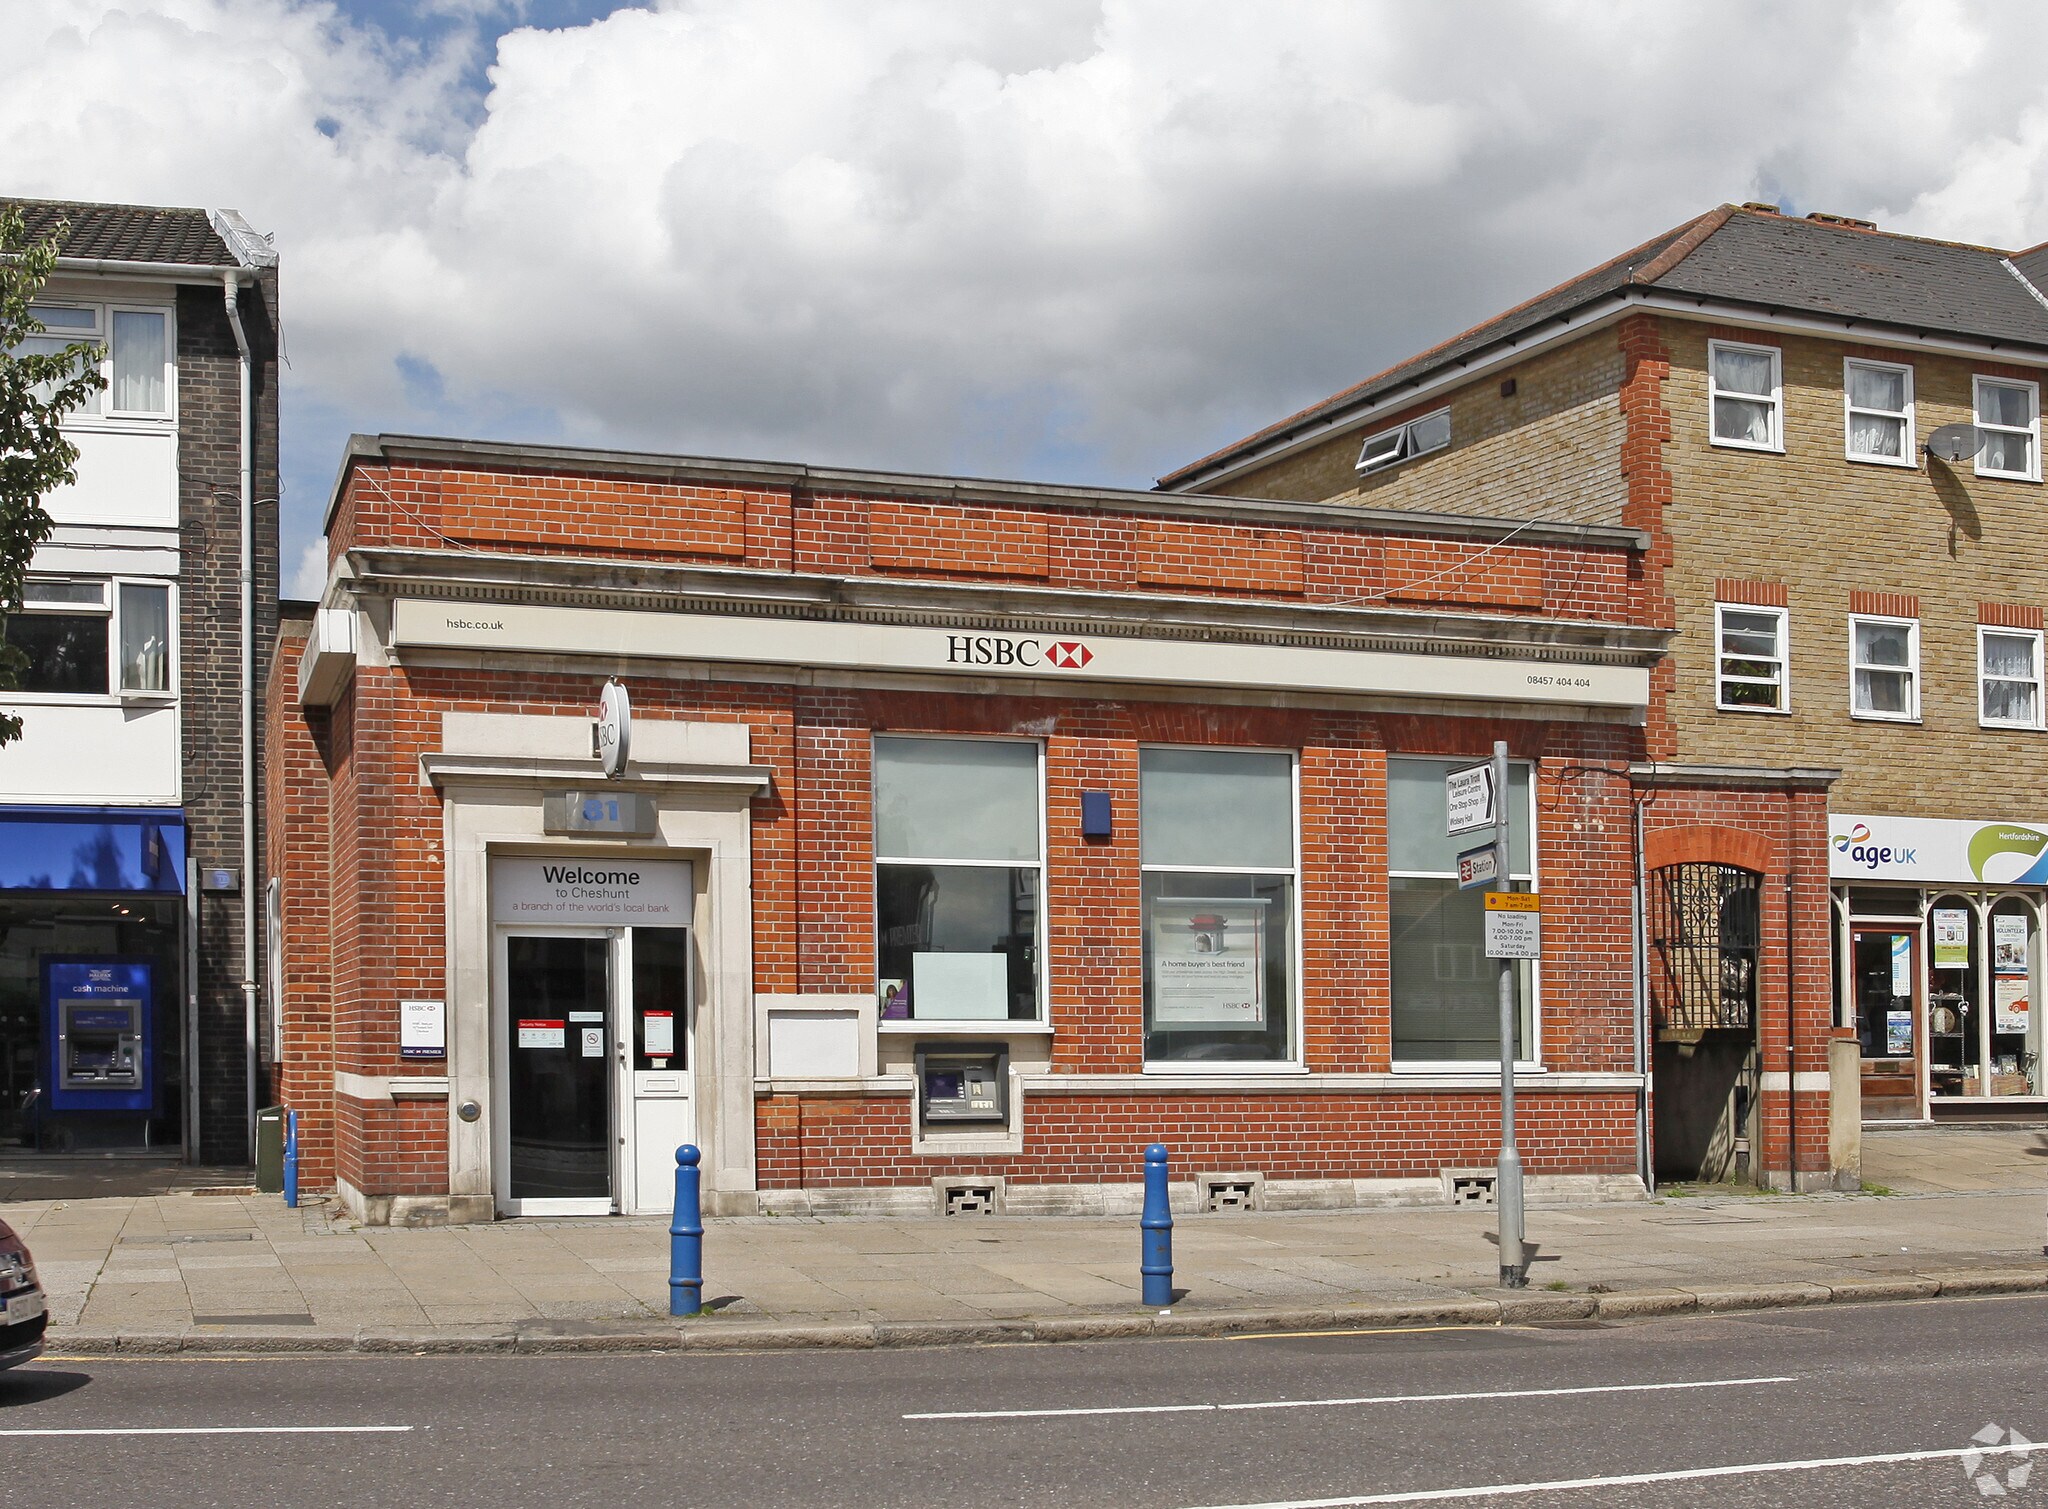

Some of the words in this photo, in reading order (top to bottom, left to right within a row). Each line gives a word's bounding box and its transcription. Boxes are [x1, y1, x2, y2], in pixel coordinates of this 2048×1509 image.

[446, 618, 504, 630] hsbc.co.uk
[946, 635, 1040, 667] HSBC
[1527, 675, 1554, 685] 08457
[1555, 677, 1572, 687] 404
[1574, 678, 1590, 688] 404
[1449, 781, 1457, 789] The
[1457, 777, 1469, 788] Laura
[1452, 788, 1467, 798] Leisure
[1467, 785, 1481, 794] Centre
[583, 799, 619, 821] 81
[1450, 803, 1458, 811] One
[1458, 800, 1468, 810] Stop
[1468, 798, 1479, 807] Shop
[1450, 816, 1465, 826] Wolsey
[1465, 813, 1473, 822] Hall
[1998, 832, 2040, 842] Hertfordshire
[1851, 845, 1892, 870] age
[1893, 847, 1917, 864] UK
[1473, 859, 1492, 874] Station
[543, 866, 641, 885] Welcome
[555, 888, 568, 898] to
[571, 887, 630, 899] Cheshunt
[512, 903, 519, 911] a
[521, 902, 553, 911] branch
[555, 902, 566, 911] of
[568, 902, 584, 912] the
[586, 903, 621, 912] world's
[623, 903, 645, 913] local
[647, 904, 670, 913] bank
[1168, 960, 1187, 968] home
[1188, 961, 1211, 969] buyer's
[73, 985, 91, 993] cash
[94, 985, 128, 993] machine
